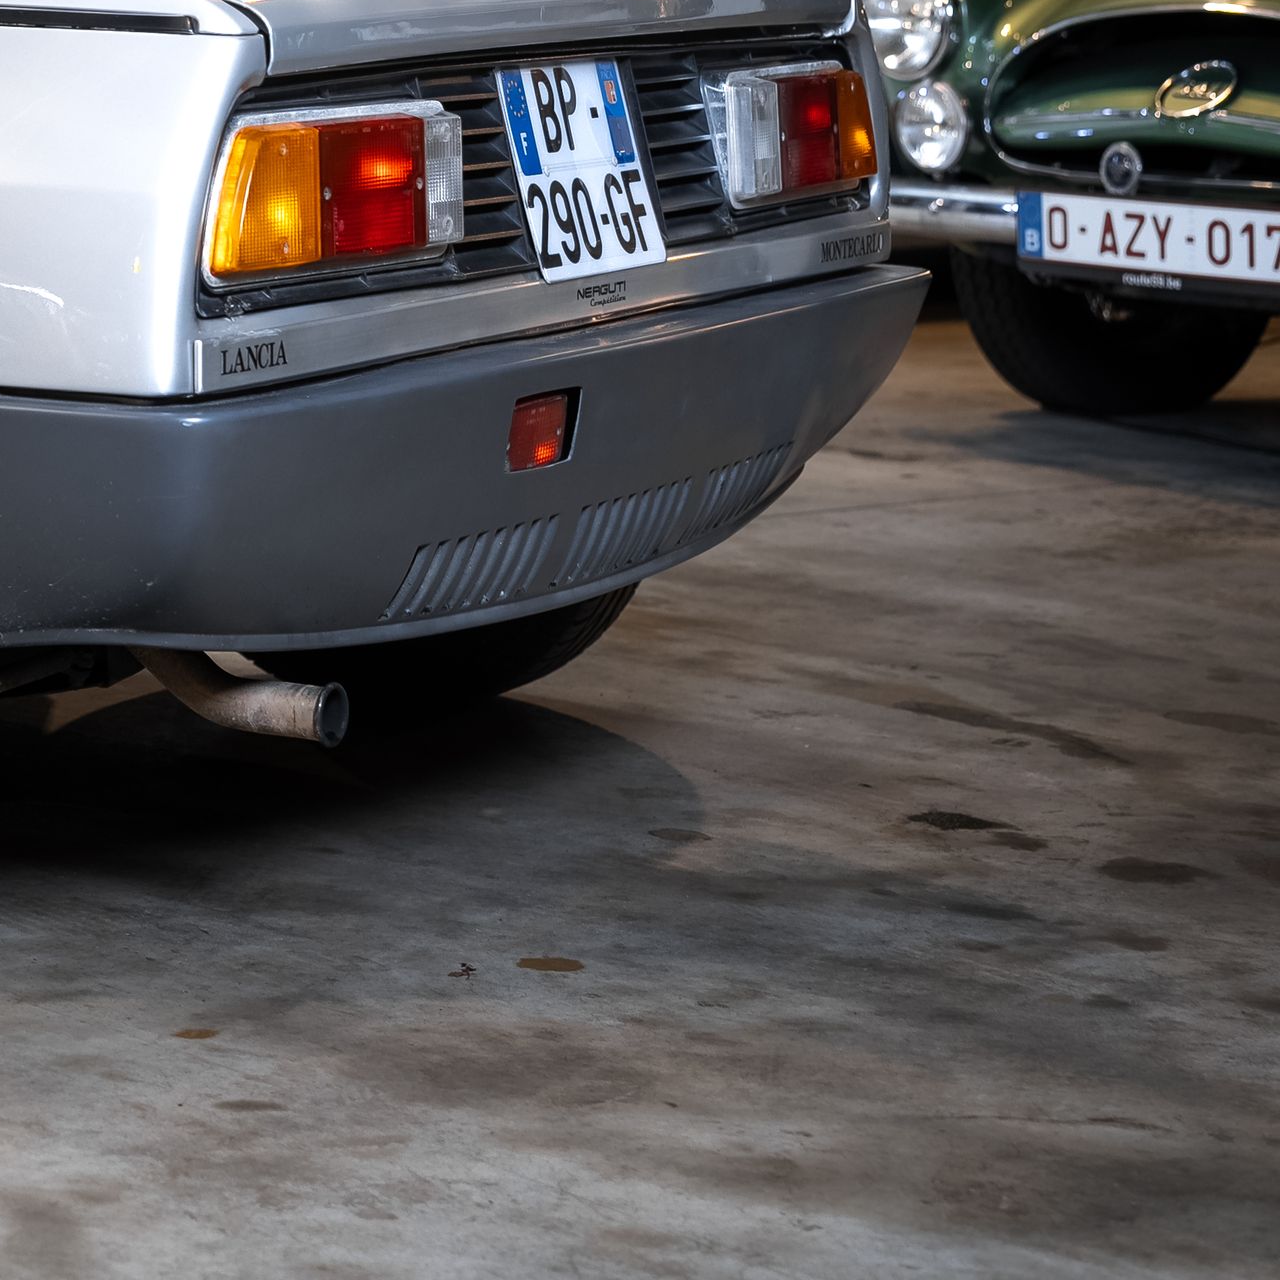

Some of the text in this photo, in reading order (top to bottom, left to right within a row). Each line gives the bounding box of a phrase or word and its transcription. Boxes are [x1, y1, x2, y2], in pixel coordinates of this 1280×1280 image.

[519, 132, 528, 156] F
[527, 169, 649, 269] 290-GF
[821, 233, 884, 263] MONTECARLO
[1024, 228, 1039, 252] B
[220, 340, 288, 376] LANCIA
